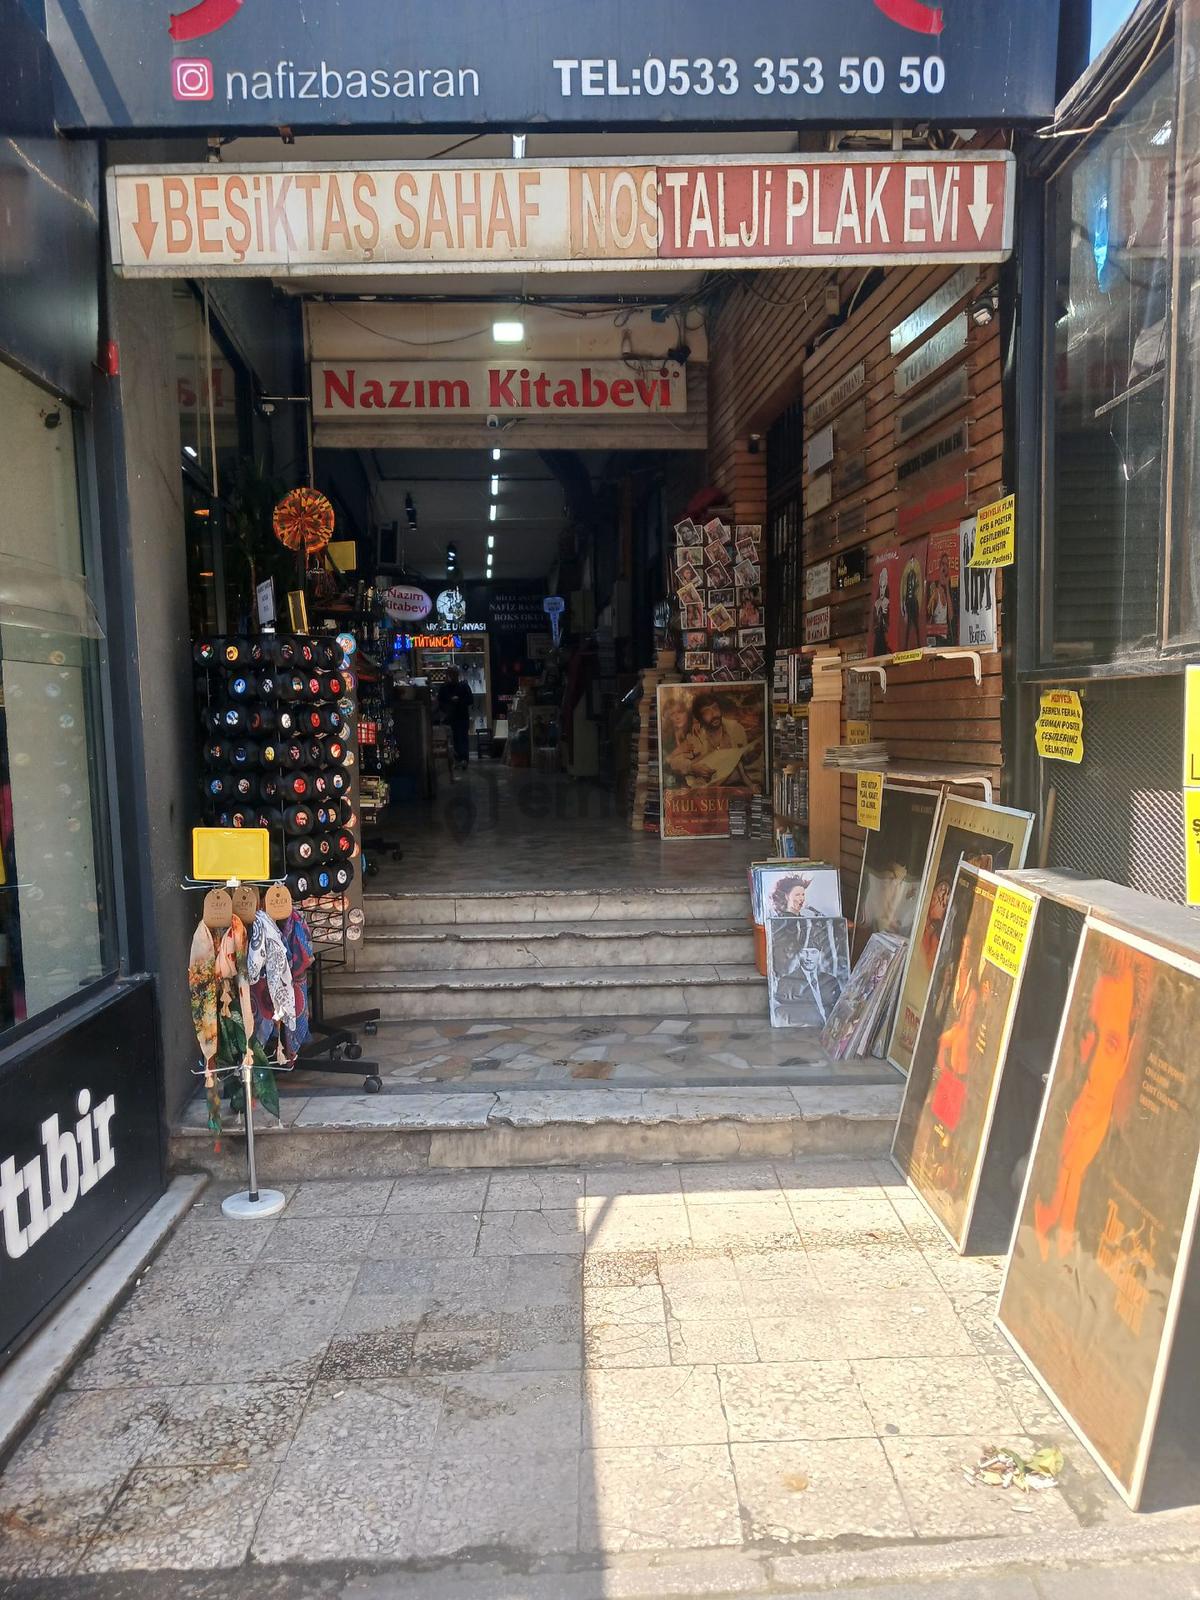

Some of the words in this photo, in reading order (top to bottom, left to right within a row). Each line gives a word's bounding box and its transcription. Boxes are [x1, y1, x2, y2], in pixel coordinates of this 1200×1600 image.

[226, 61, 480, 100] nafizbasaran
[553, 57, 739, 97] TEL:0533
[753, 57, 824, 95] 353
[838, 57, 885, 94] 50
[899, 56, 945, 94] 50
[393, 171, 541, 251] SAHAF
[785, 166, 891, 246] PLAK
[323, 368, 471, 409] Nazım
[487, 367, 673, 409] Kitabevi
